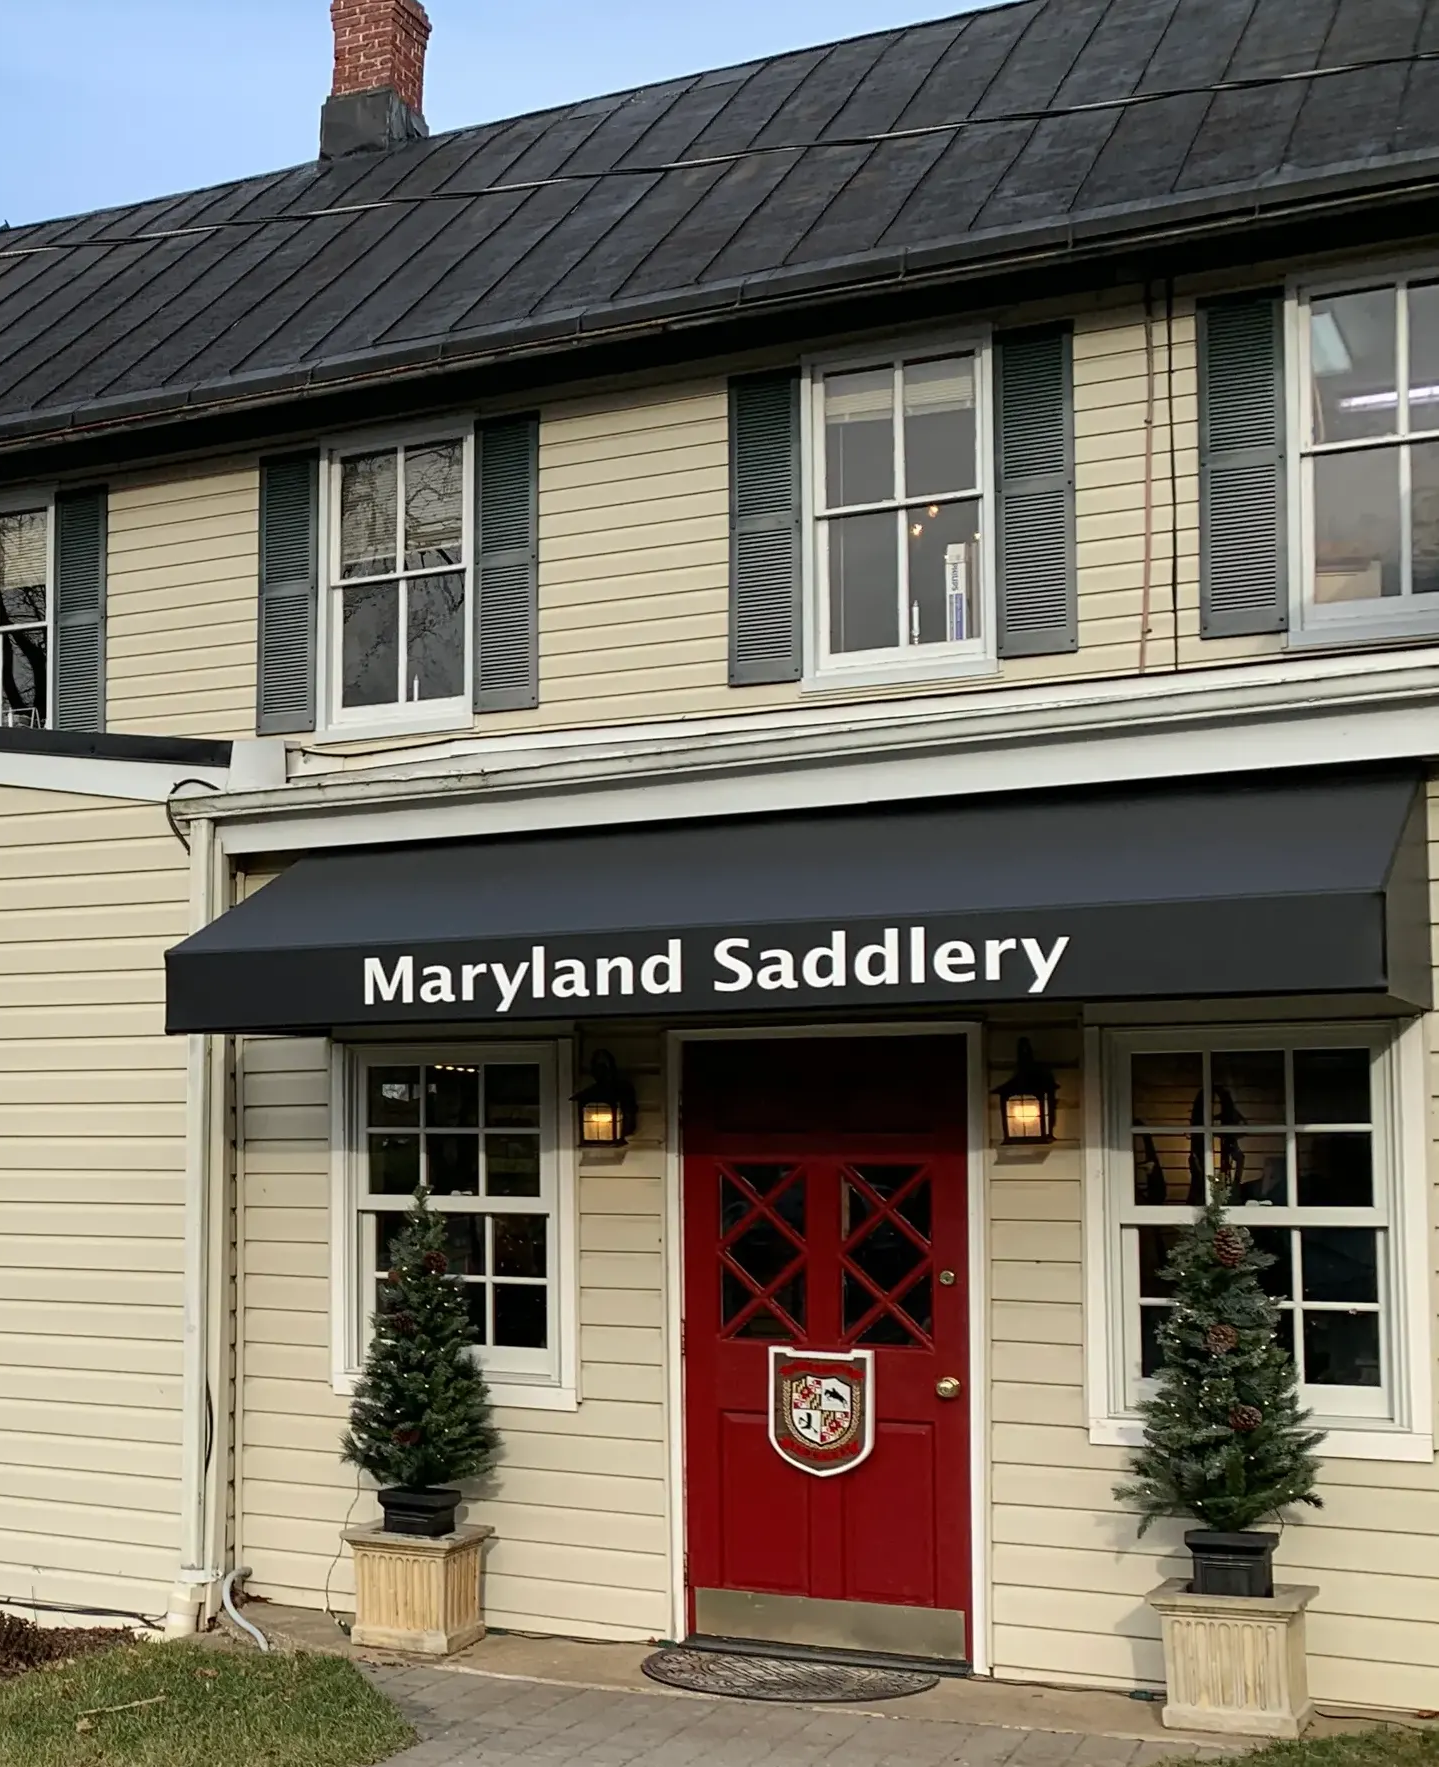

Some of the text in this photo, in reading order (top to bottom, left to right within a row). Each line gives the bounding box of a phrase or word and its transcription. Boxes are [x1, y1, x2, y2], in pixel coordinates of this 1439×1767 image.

[951, 563, 959, 591] PHILIPS
[364, 926, 1070, 1013] Maryland Saddlery
